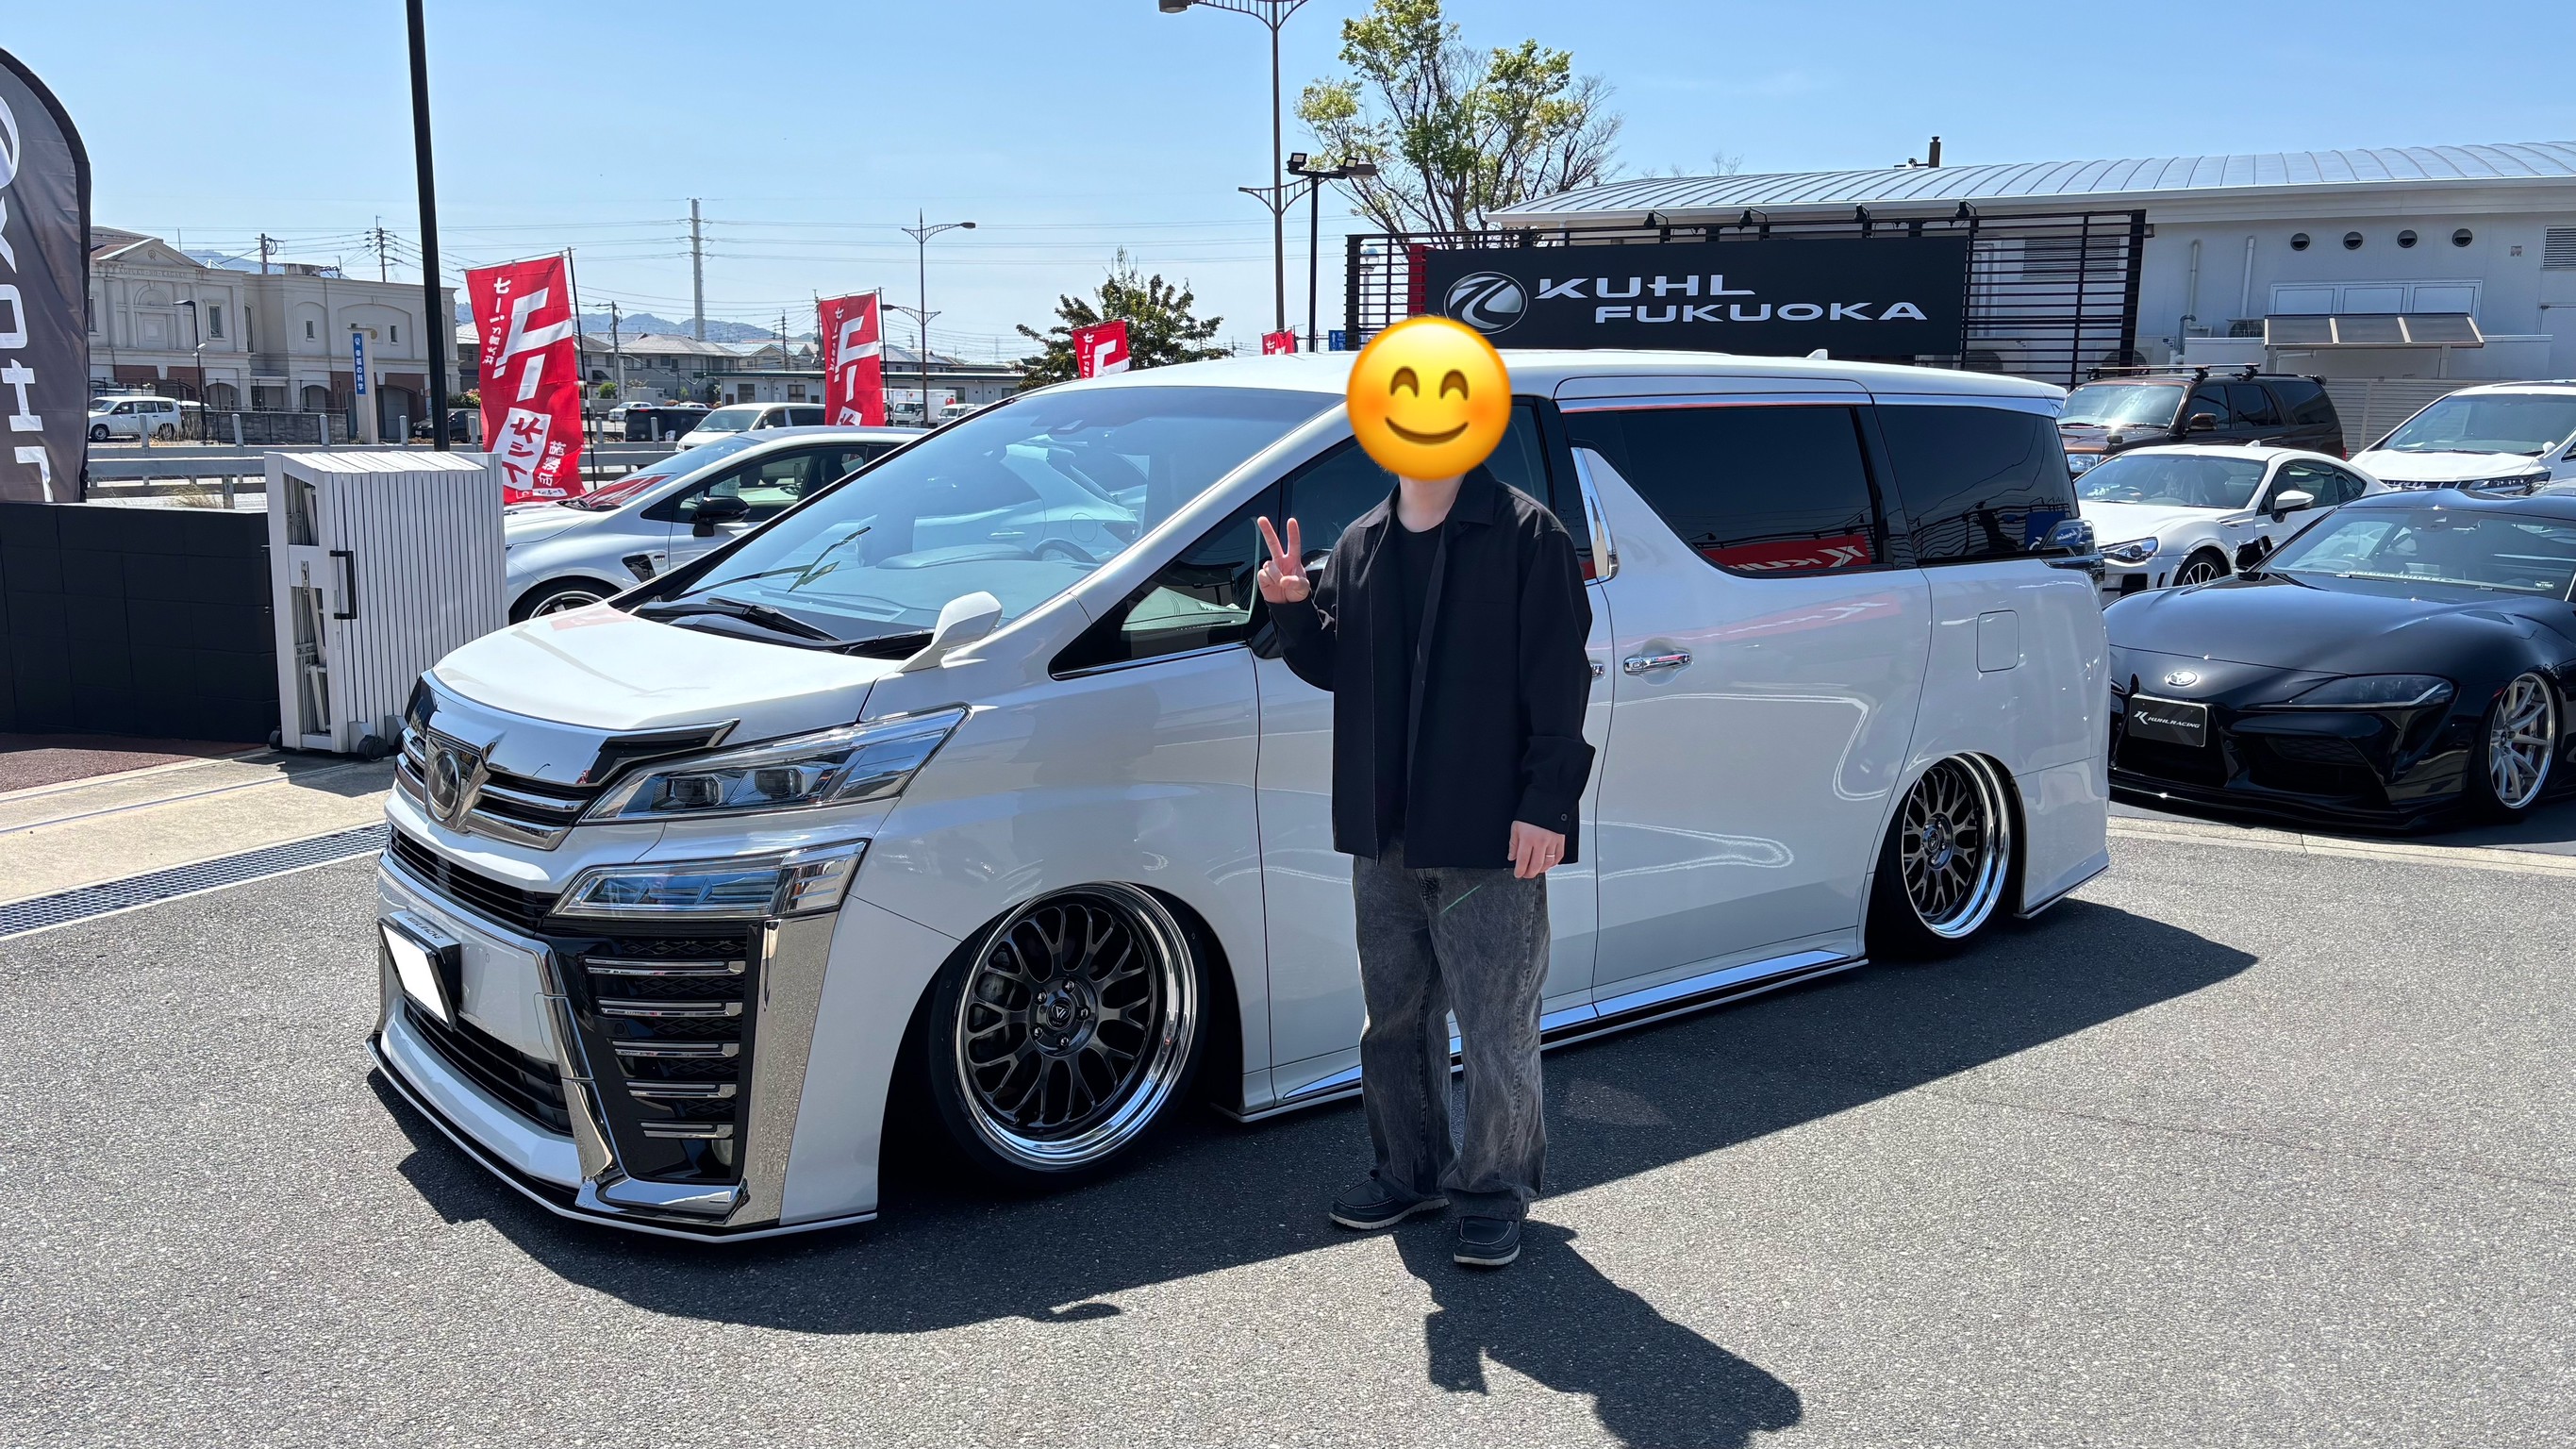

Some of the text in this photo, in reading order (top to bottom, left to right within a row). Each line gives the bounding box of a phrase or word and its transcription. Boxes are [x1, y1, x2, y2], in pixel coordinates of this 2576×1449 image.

[1535, 275, 1755, 299] KUHL
[1595, 302, 1927, 323] FUKUOKA
[2148, 716, 2169, 724] KUHL
[2169, 720, 2201, 728] RACING
